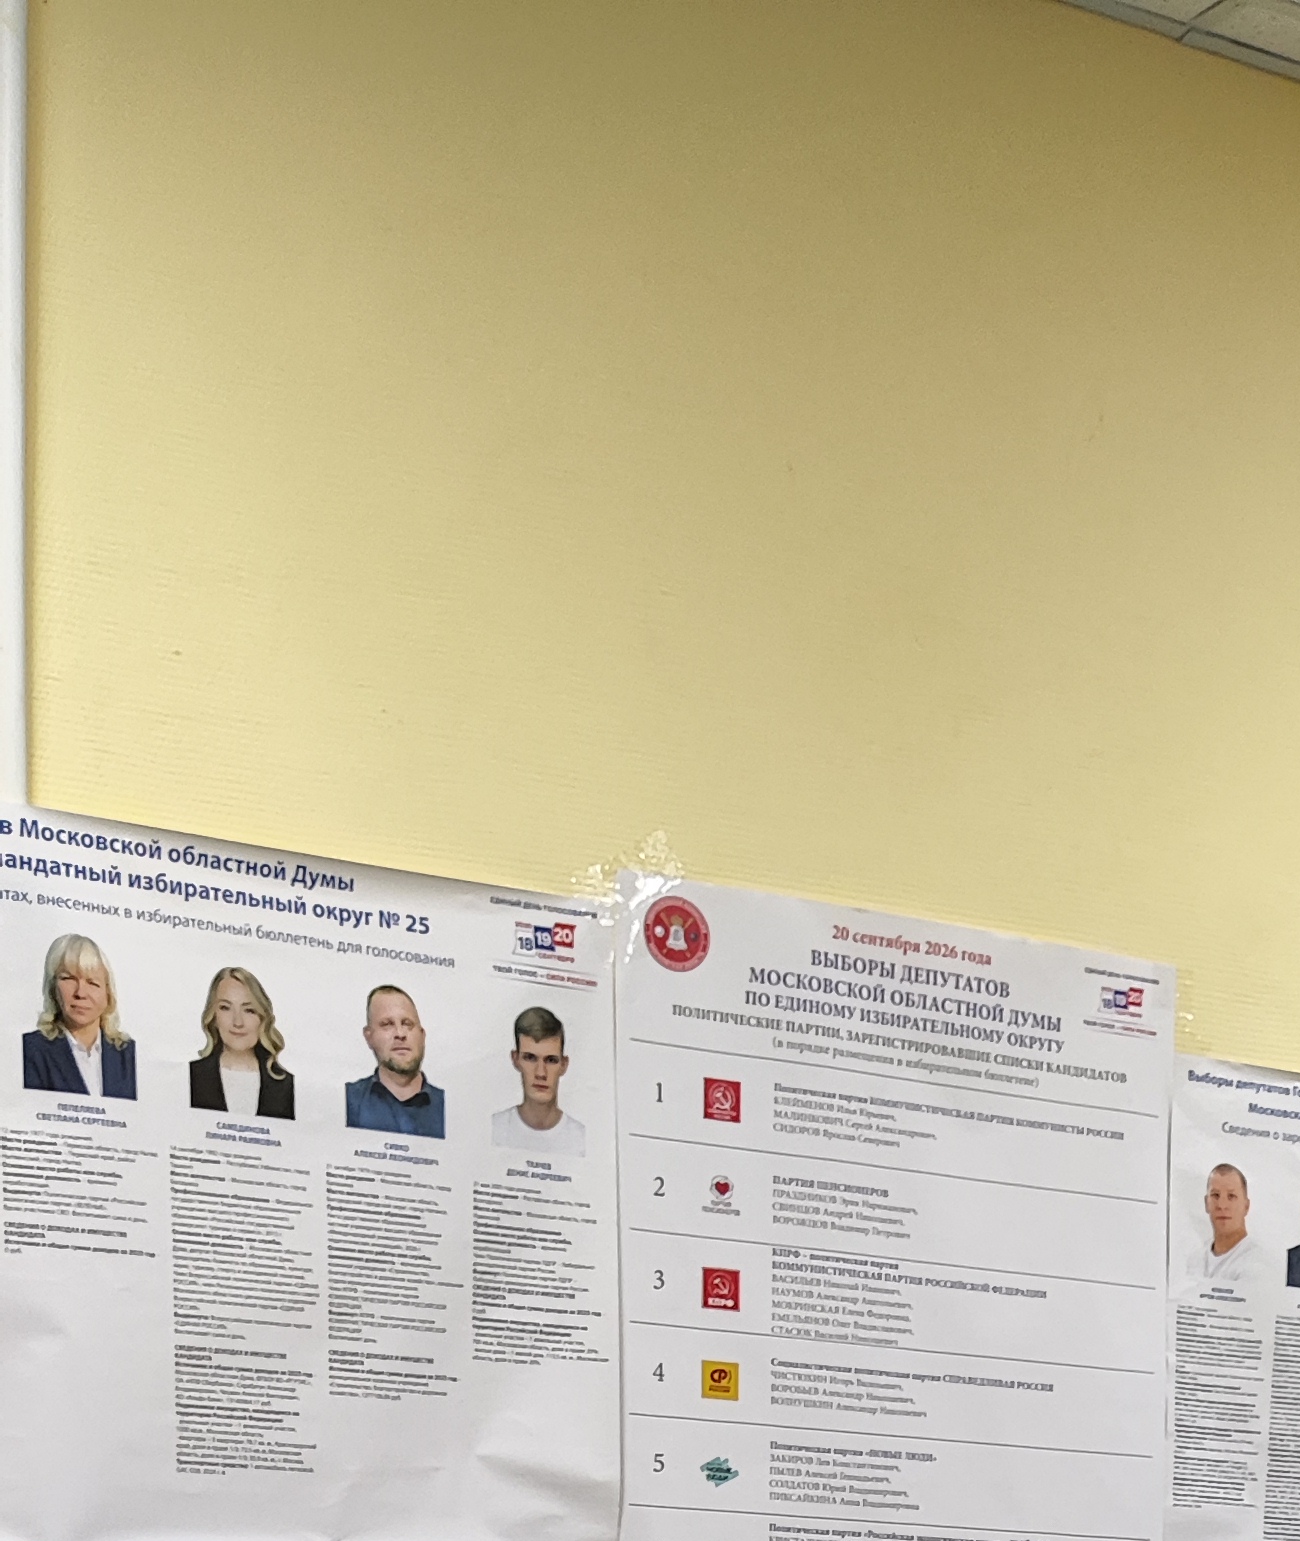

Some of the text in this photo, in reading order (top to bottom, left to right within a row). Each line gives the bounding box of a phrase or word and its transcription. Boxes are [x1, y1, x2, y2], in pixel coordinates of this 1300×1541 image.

[0, 818, 355, 892] в Московской областной Думы
[0, 853, 430, 935] андатный избирательный округ № 25
[37, 893, 120, 917] внесенных
[124, 908, 133, 919] в
[136, 908, 252, 937] избирательный
[256, 925, 334, 950] бюллетень
[337, 941, 362, 954] для
[366, 945, 456, 969] голосования
[518, 928, 573, 951] 18 19 20
[832, 925, 991, 965] 20 сентября 2026 года
[811, 950, 1009, 998] ВЫБОРЫ ДЕПУТАТОВ
[749, 967, 885, 1003] МОСКОВСКОЙ
[890, 990, 1004, 1023] ОБЛАСТНОЙ
[1008, 1009, 1061, 1032] ДУМЫ
[672, 1005, 1127, 1083] ПОЛИТИЧЕСКИЕ ПАРТИИ, ЗАРЕГИСТРИРОВАВШИЕ СПИСКИ КАНДИДАТОВ
[745, 991, 1064, 1053] ПО ЕДИНОМУ ИЗБИРАТЕЛЬНОМУ ОКРУГУ
[655, 1083, 663, 1102] 1
[652, 1177, 665, 1197] 2
[653, 1270, 665, 1290] 3
[653, 1362, 665, 1382] 4
[652, 1453, 665, 1473] 5
